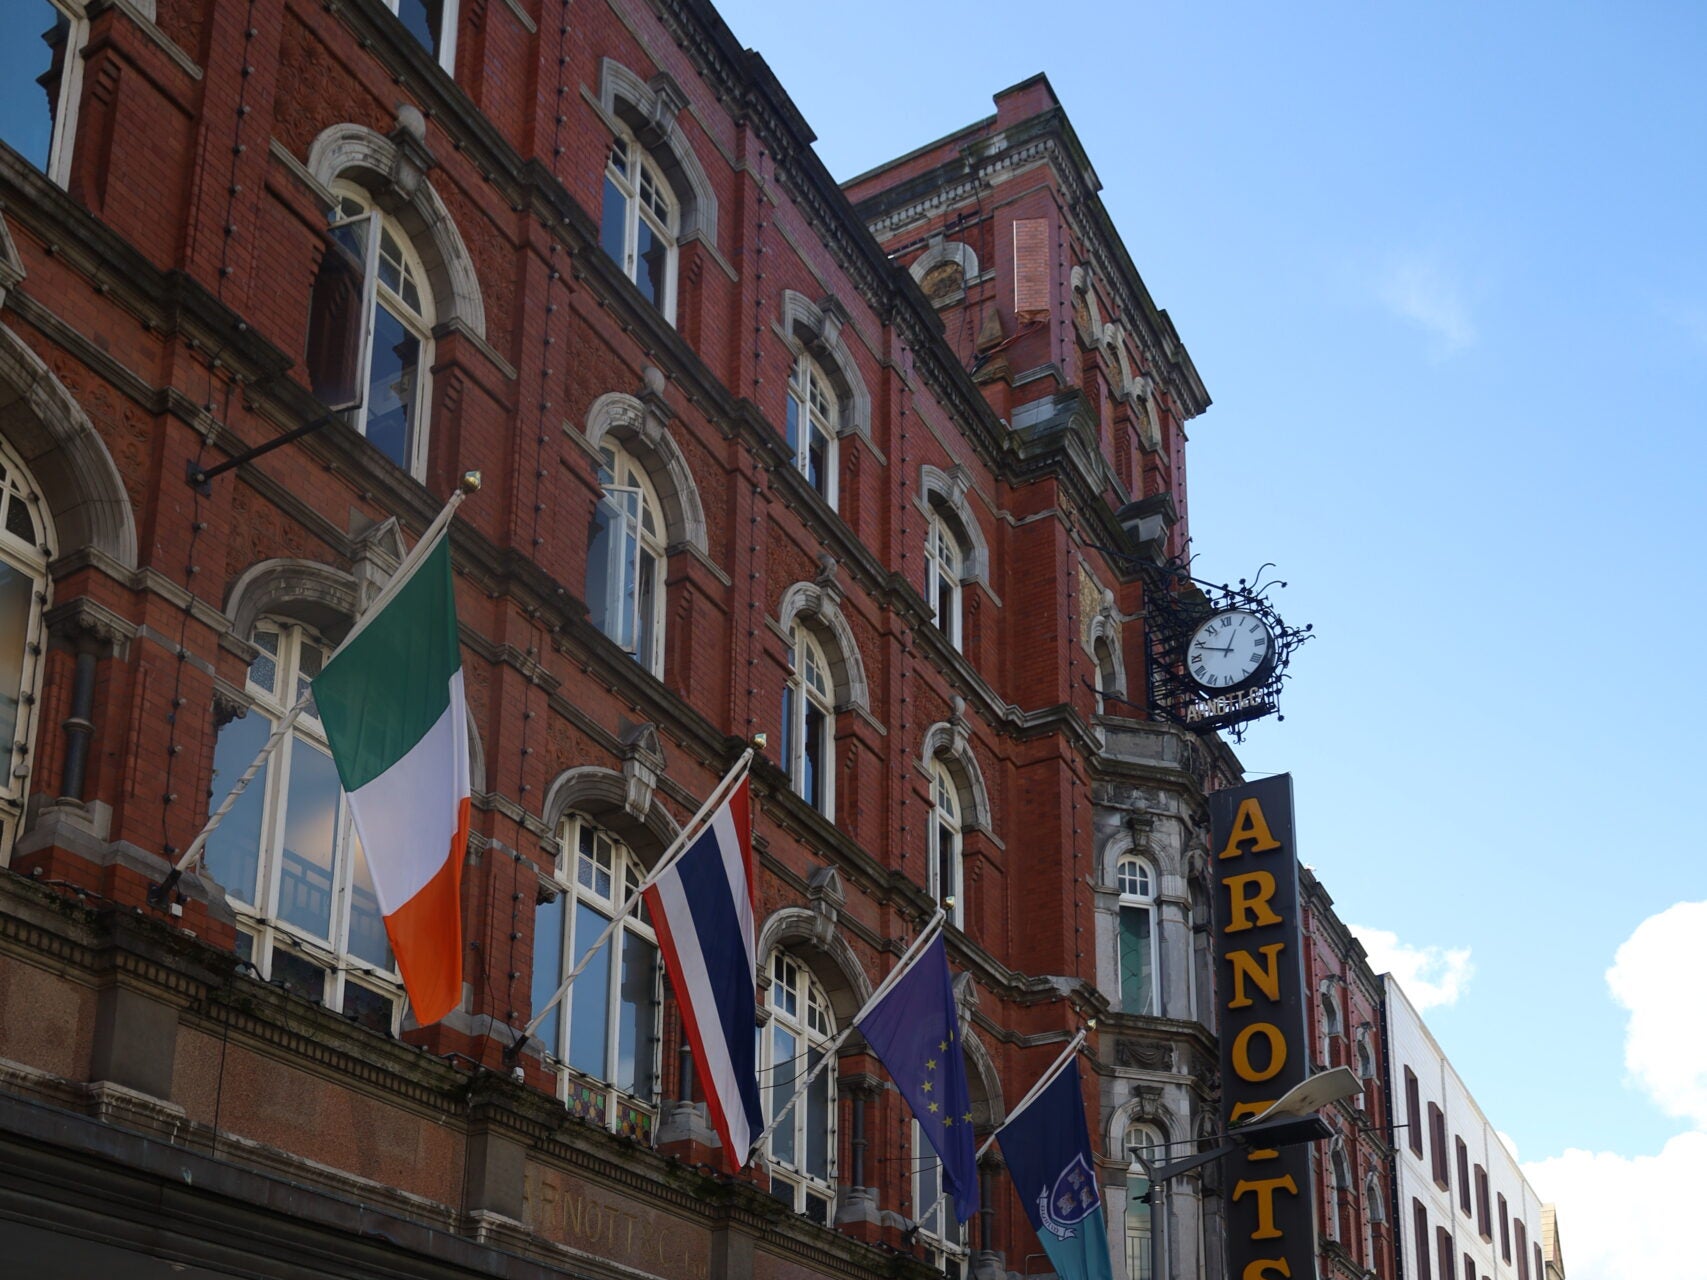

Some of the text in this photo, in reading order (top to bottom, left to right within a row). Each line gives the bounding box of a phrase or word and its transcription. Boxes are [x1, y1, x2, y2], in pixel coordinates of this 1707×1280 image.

[1221, 616, 1231, 627] XII
[1205, 625, 1217, 636] XI
[1192, 653, 1202, 663] IX
